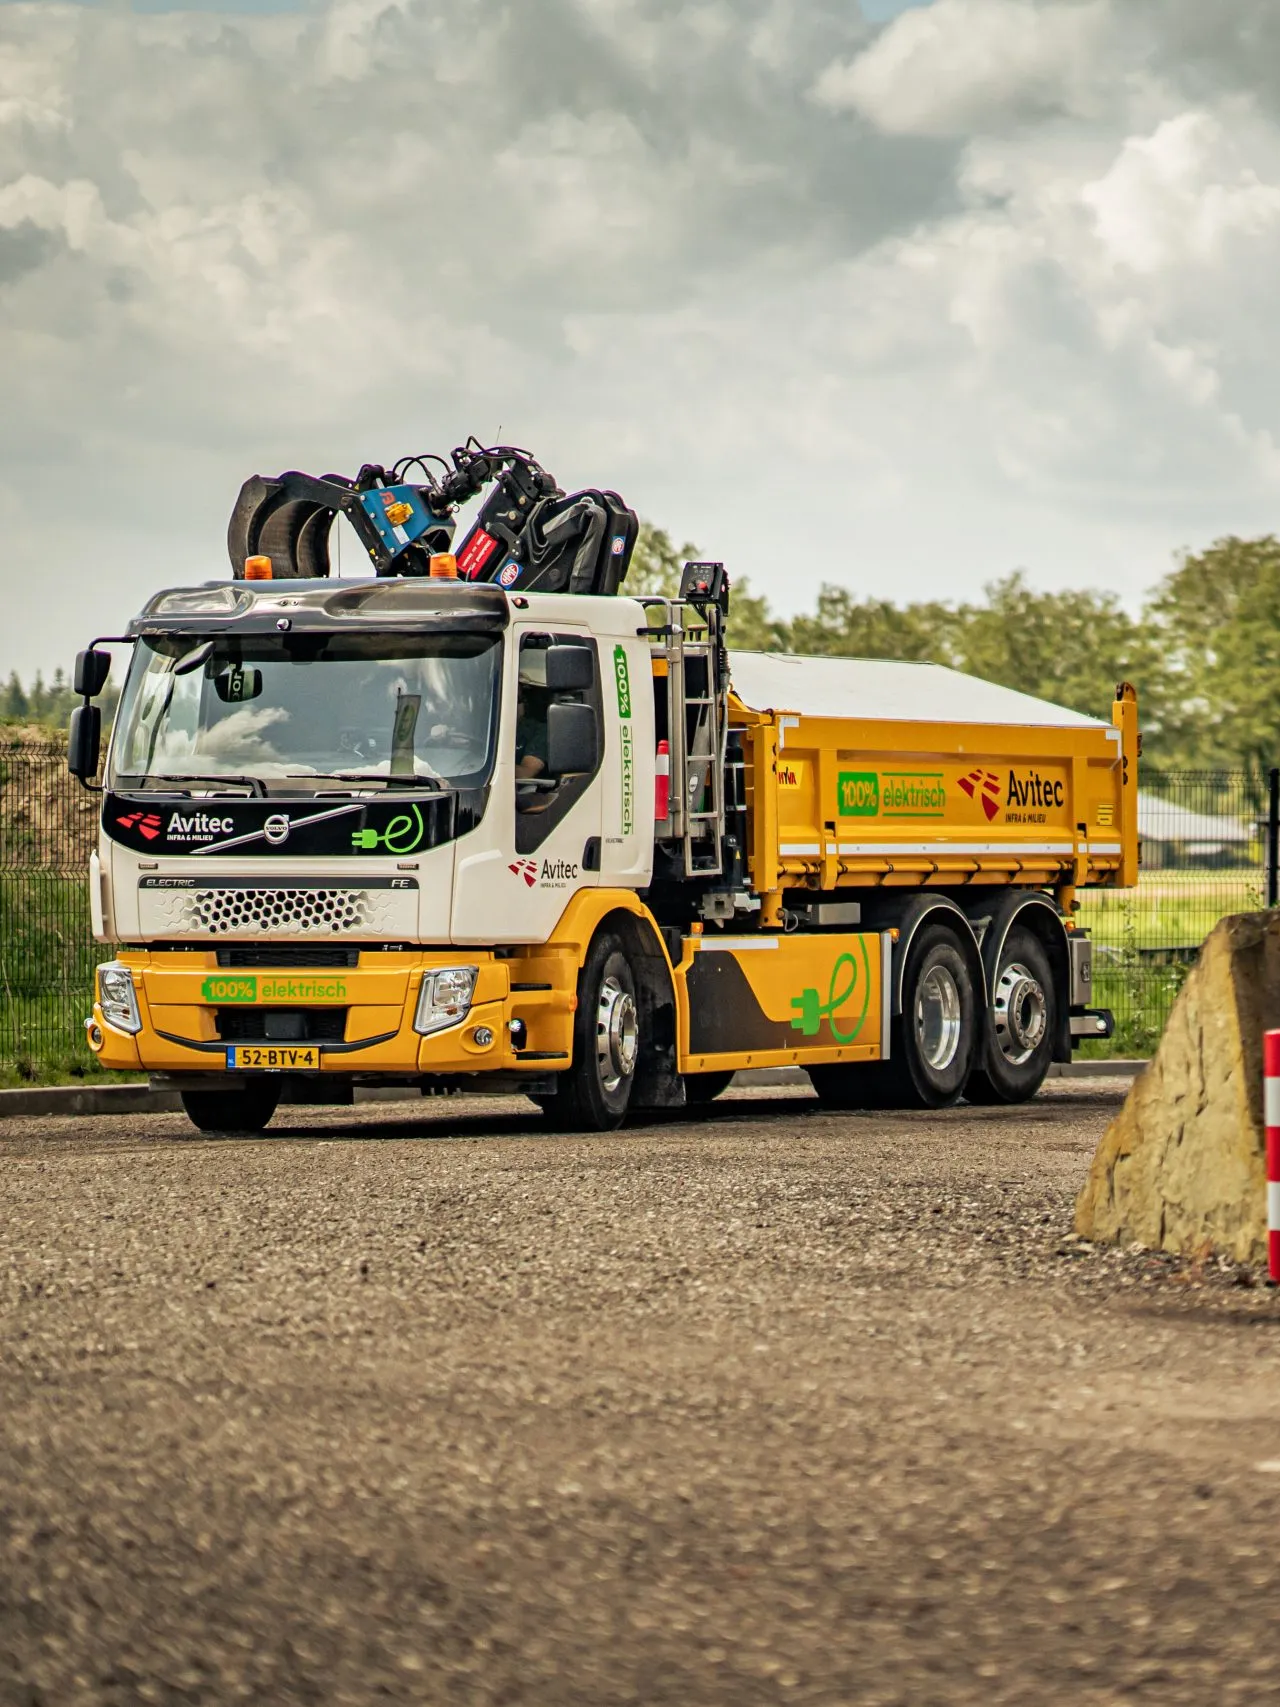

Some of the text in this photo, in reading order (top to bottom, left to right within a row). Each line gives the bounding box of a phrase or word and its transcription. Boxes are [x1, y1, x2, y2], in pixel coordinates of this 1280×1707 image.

[616, 656, 632, 835] 100% elektrisch
[778, 767, 797, 784] HYVA
[842, 780, 946, 807] 100% elektrisch
[1007, 770, 1064, 807] Avitec
[167, 812, 234, 833] Avitec
[1005, 813, 1021, 823] INFRA
[541, 859, 578, 879] Avitec
[146, 879, 195, 887] ELECTRIC
[391, 879, 410, 888] FE
[209, 980, 346, 998] 100% elektrisch
[242, 1050, 313, 1065] 52-BTV-4
